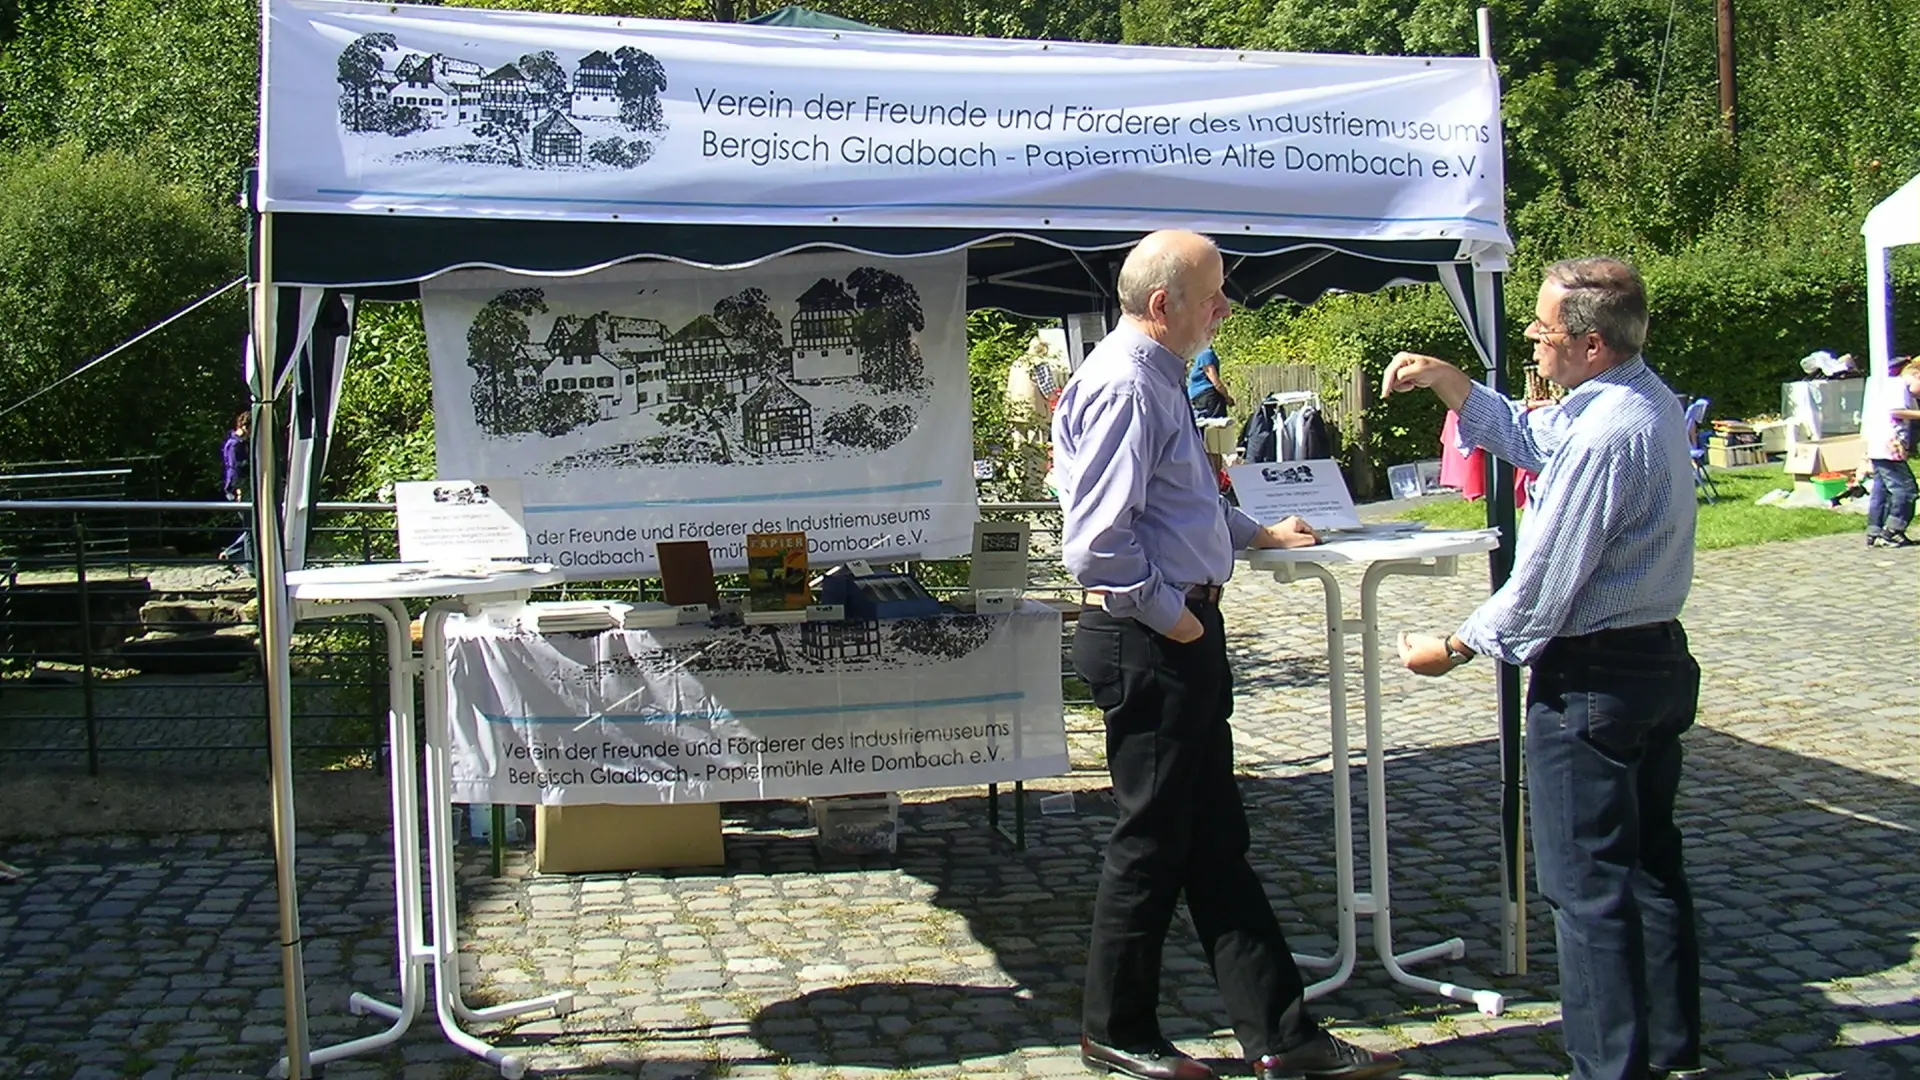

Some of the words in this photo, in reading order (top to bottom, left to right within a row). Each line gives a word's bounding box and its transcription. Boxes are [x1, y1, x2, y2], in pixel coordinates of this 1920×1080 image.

[694, 88, 793, 118] Verein
[804, 93, 857, 121] der
[864, 96, 987, 127] Freunde
[997, 104, 1054, 131] und
[1062, 106, 1181, 136] Förderer
[1189, 113, 1241, 135] des
[1248, 111, 1490, 144] Industriemuseums
[703, 130, 829, 166] Bergisch
[840, 136, 996, 167] Gladbach
[1026, 142, 1212, 171] Papiermühle
[1221, 142, 1276, 170] Alte
[1284, 145, 1424, 177] Dombach
[1431, 154, 1486, 180] e.V.
[536, 530, 565, 546] der
[569, 526, 638, 544] Freunde
[641, 523, 674, 541] und
[680, 521, 747, 539] Förderer
[752, 518, 782, 534] des
[787, 507, 930, 533] Industriemuseums
[558, 548, 645, 567] Gladbach
[808, 532, 891, 555] Dombach
[896, 529, 928, 546] e.V.
[502, 740, 560, 760] Verein
[565, 741, 598, 761] der
[602, 740, 680, 760] Freunde
[685, 738, 722, 757] und
[727, 735, 806, 754] Förderer
[811, 733, 845, 751] des
[850, 723, 1009, 748] Industriemuseums
[509, 766, 585, 788] Bergisch
[590, 764, 689, 785] Gladbach
[706, 760, 823, 784] Papiermühle
[829, 756, 866, 775] Alte
[871, 750, 964, 772] Dombach
[970, 745, 1005, 765] e.V.
